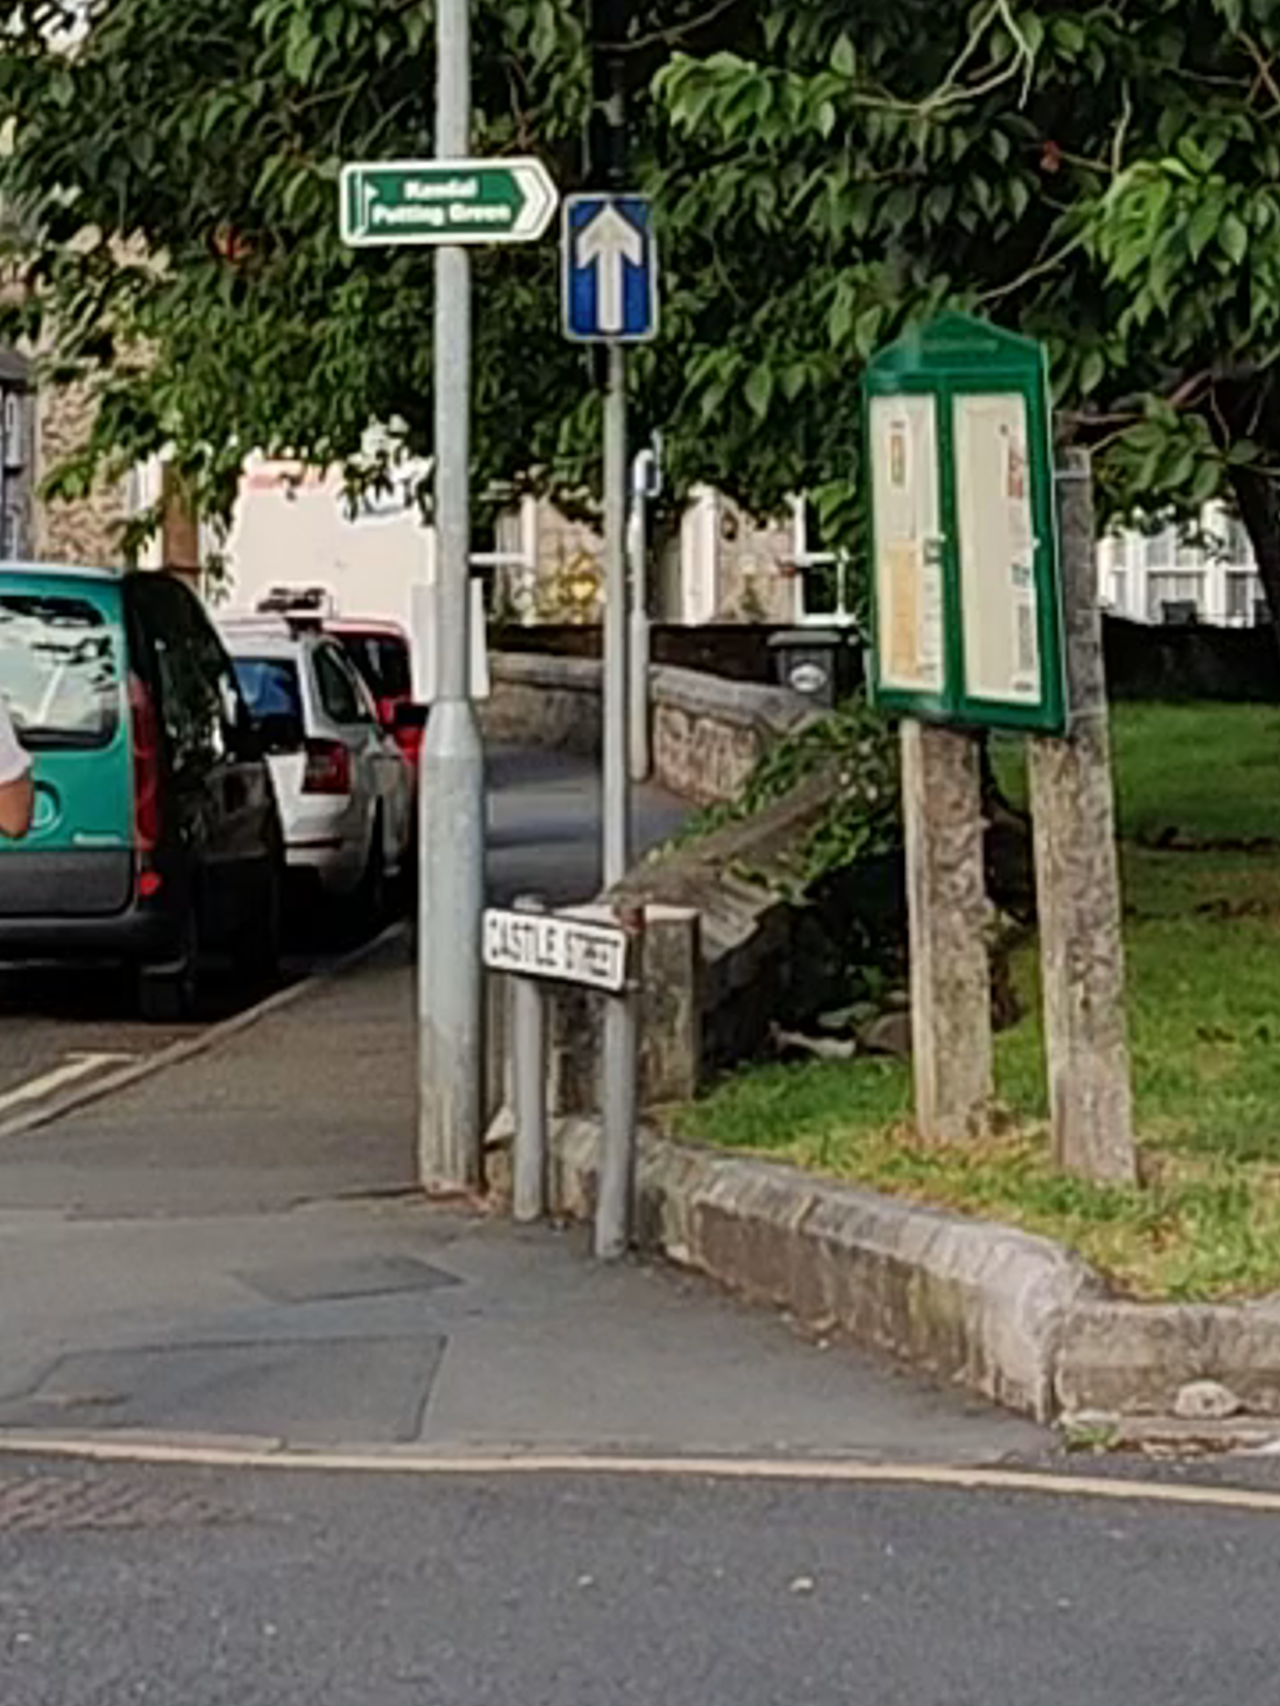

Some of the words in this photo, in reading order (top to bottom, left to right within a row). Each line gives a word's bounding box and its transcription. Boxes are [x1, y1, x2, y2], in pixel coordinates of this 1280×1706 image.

[403, 177, 479, 199] Kendal
[371, 204, 445, 226] Putting
[448, 203, 512, 223] Green
[488, 916, 558, 968] CASTLE
[565, 928, 620, 978] STREET
